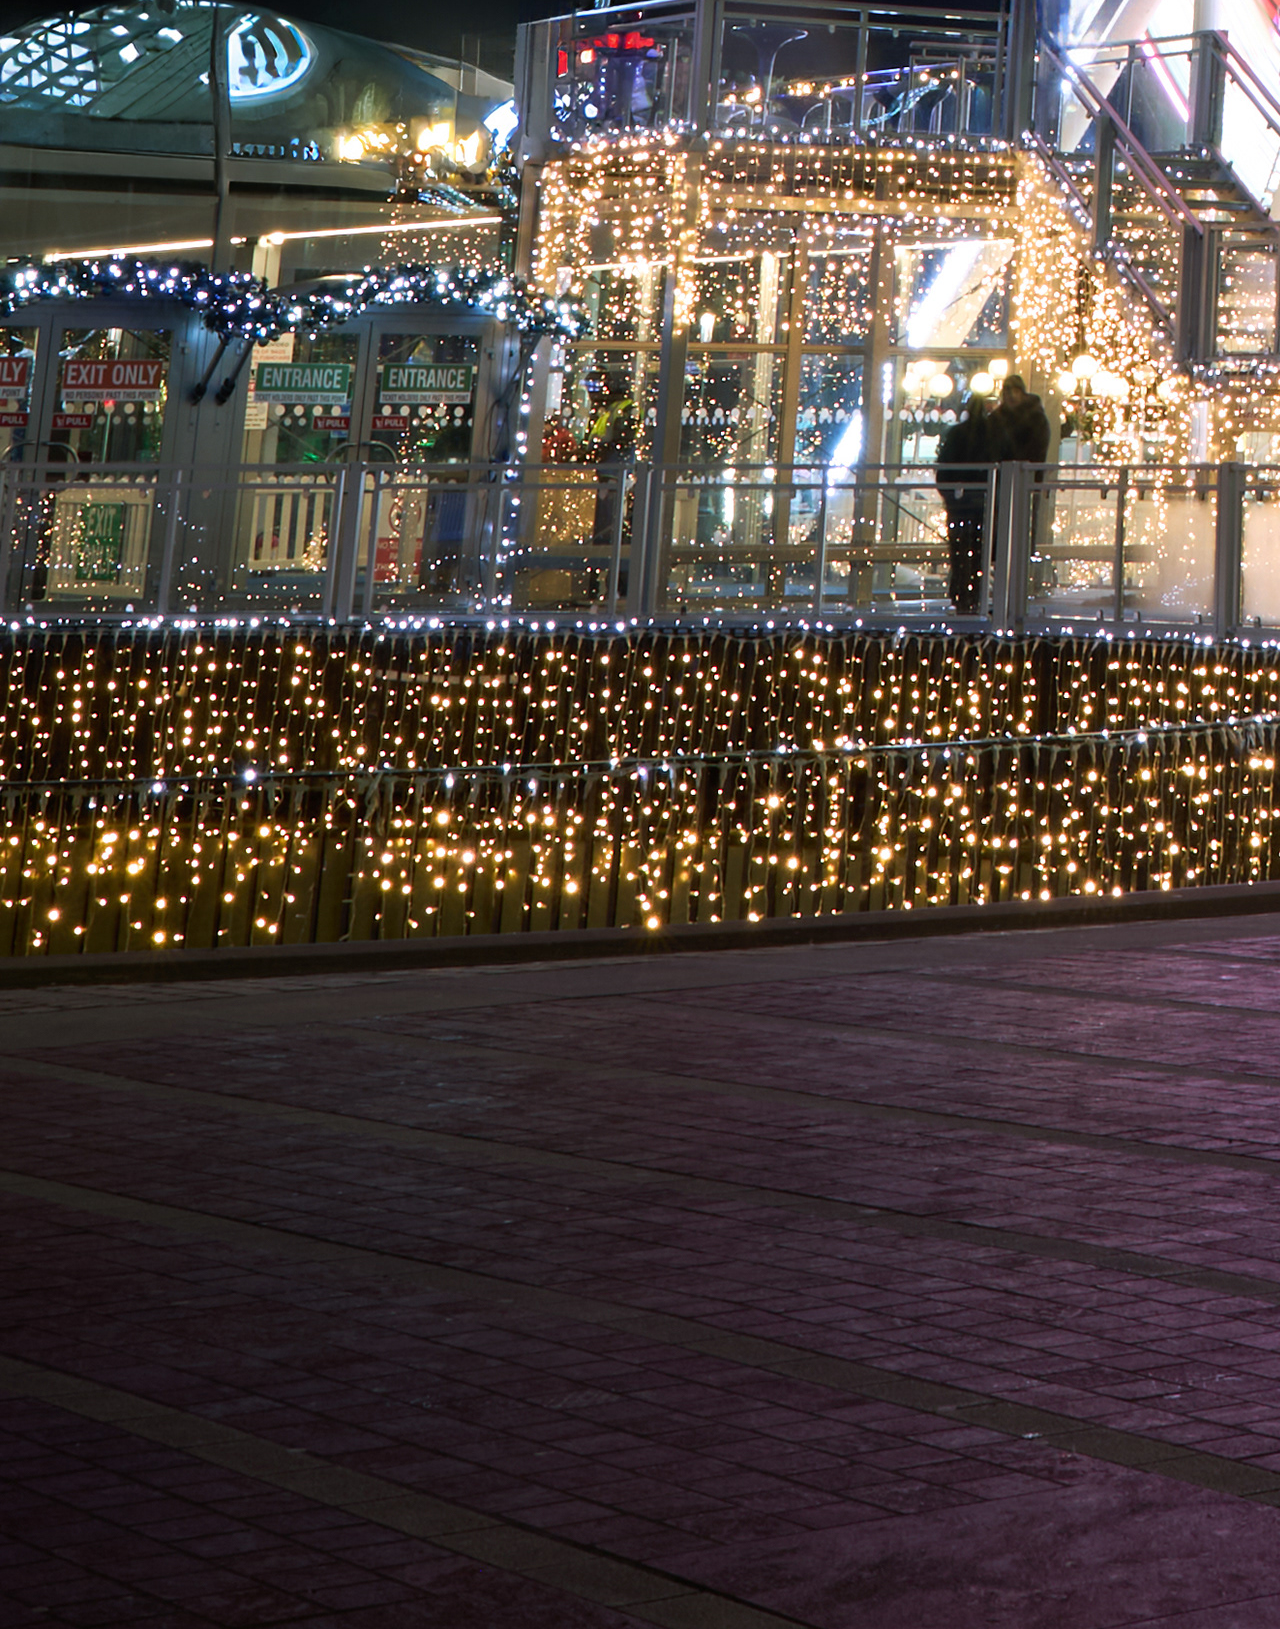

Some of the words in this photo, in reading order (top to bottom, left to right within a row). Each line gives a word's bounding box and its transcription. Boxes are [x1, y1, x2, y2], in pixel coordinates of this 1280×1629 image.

[0, 362, 24, 382] LY
[66, 364, 108, 385] EXIT
[112, 364, 159, 385] ONLY
[263, 368, 343, 389] ENTRANCE
[389, 368, 465, 389] ENTRANCE
[105, 391, 121, 399] PAST
[123, 391, 136, 399] THIS
[137, 391, 156, 399] POINT
[2, 415, 24, 425] PULL
[65, 416, 88, 426] PULL
[326, 419, 346, 428] PULL
[383, 419, 403, 428] PULL
